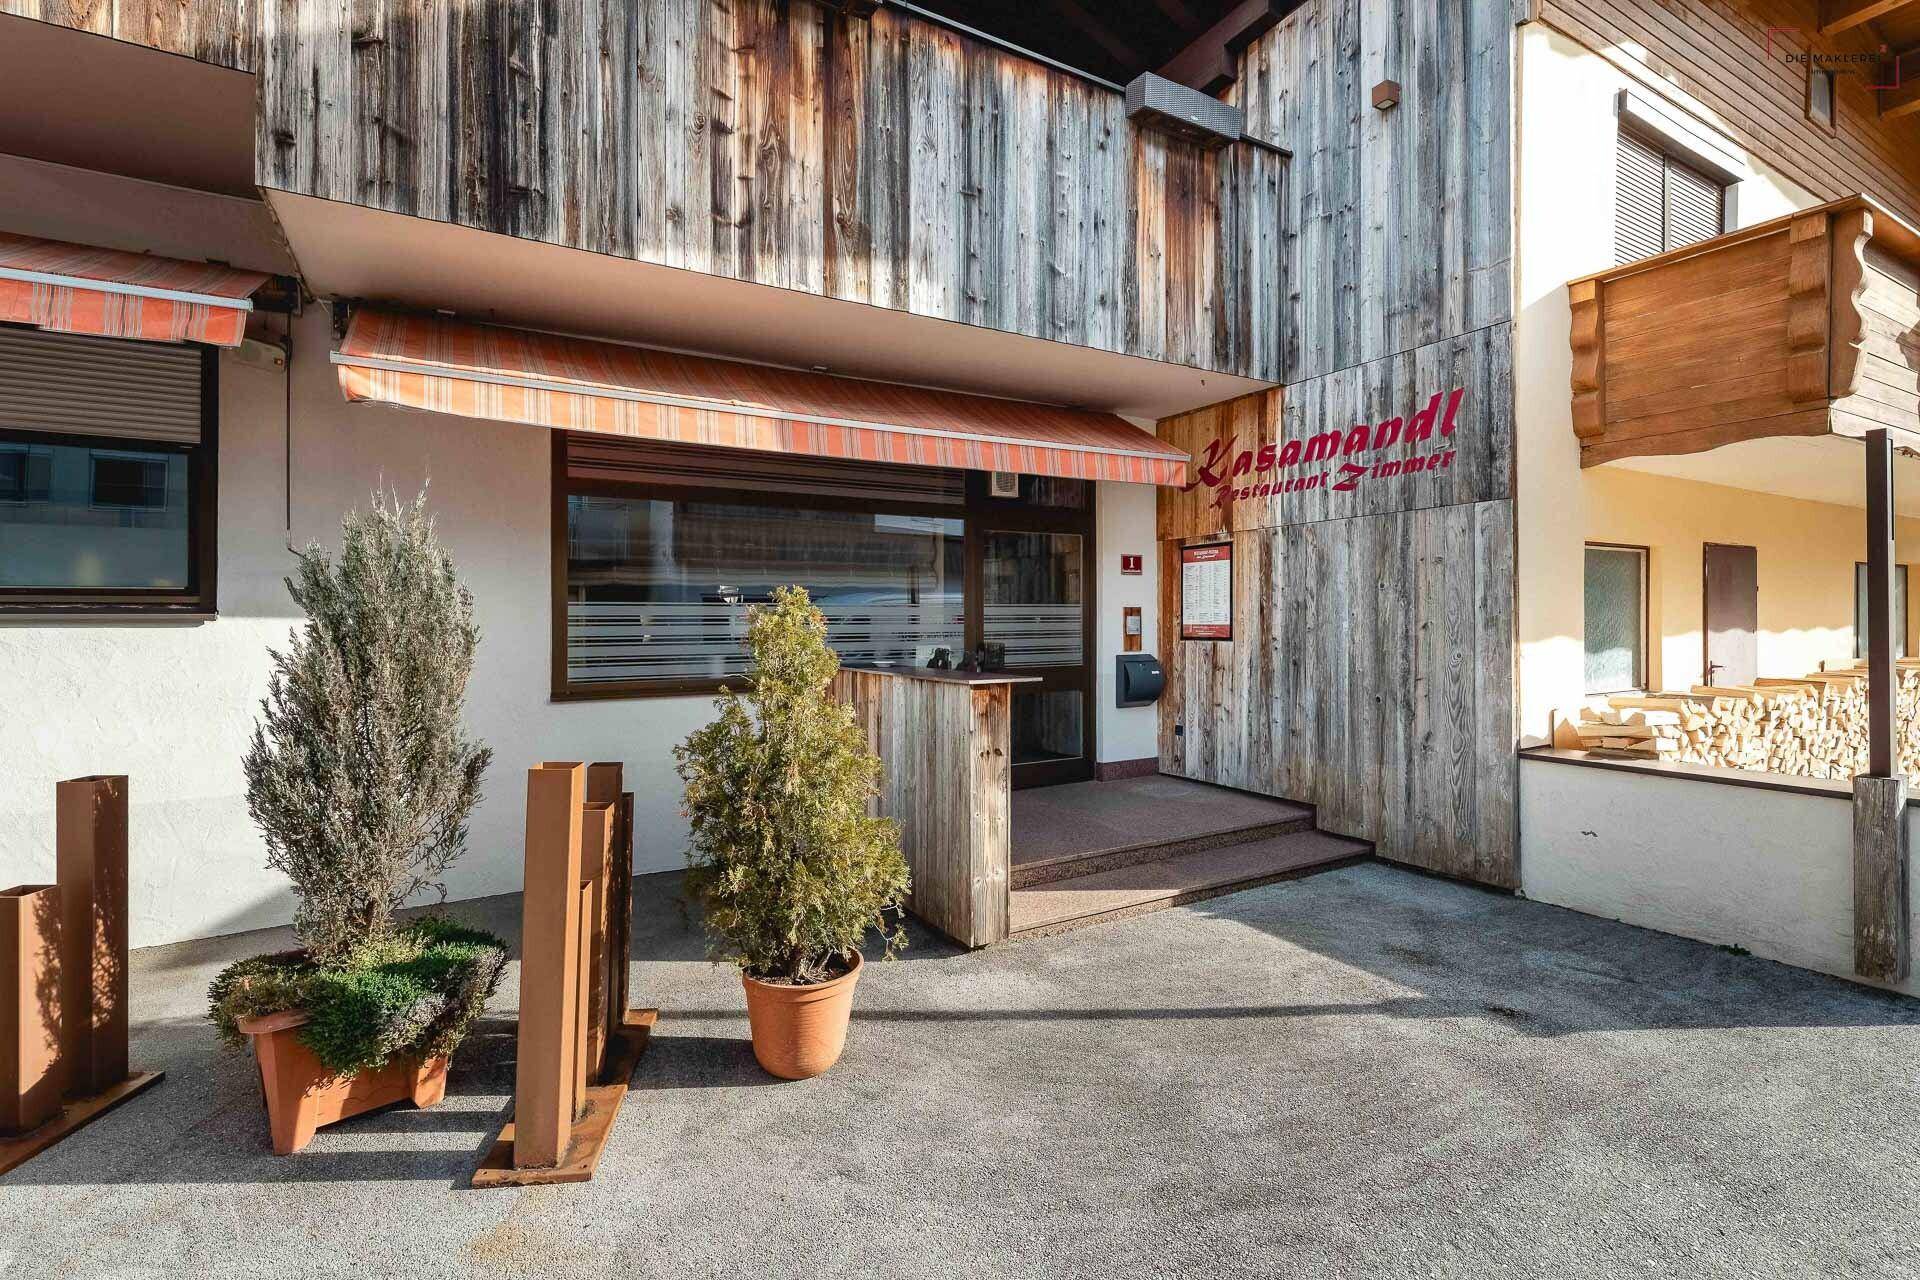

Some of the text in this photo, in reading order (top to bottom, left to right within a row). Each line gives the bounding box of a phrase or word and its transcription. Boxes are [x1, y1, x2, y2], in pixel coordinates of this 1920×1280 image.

[1180, 387, 1465, 493] Kasamandl
[1209, 450, 1457, 509] Restaurant Zimmer
[1129, 557, 1135, 568] 1
